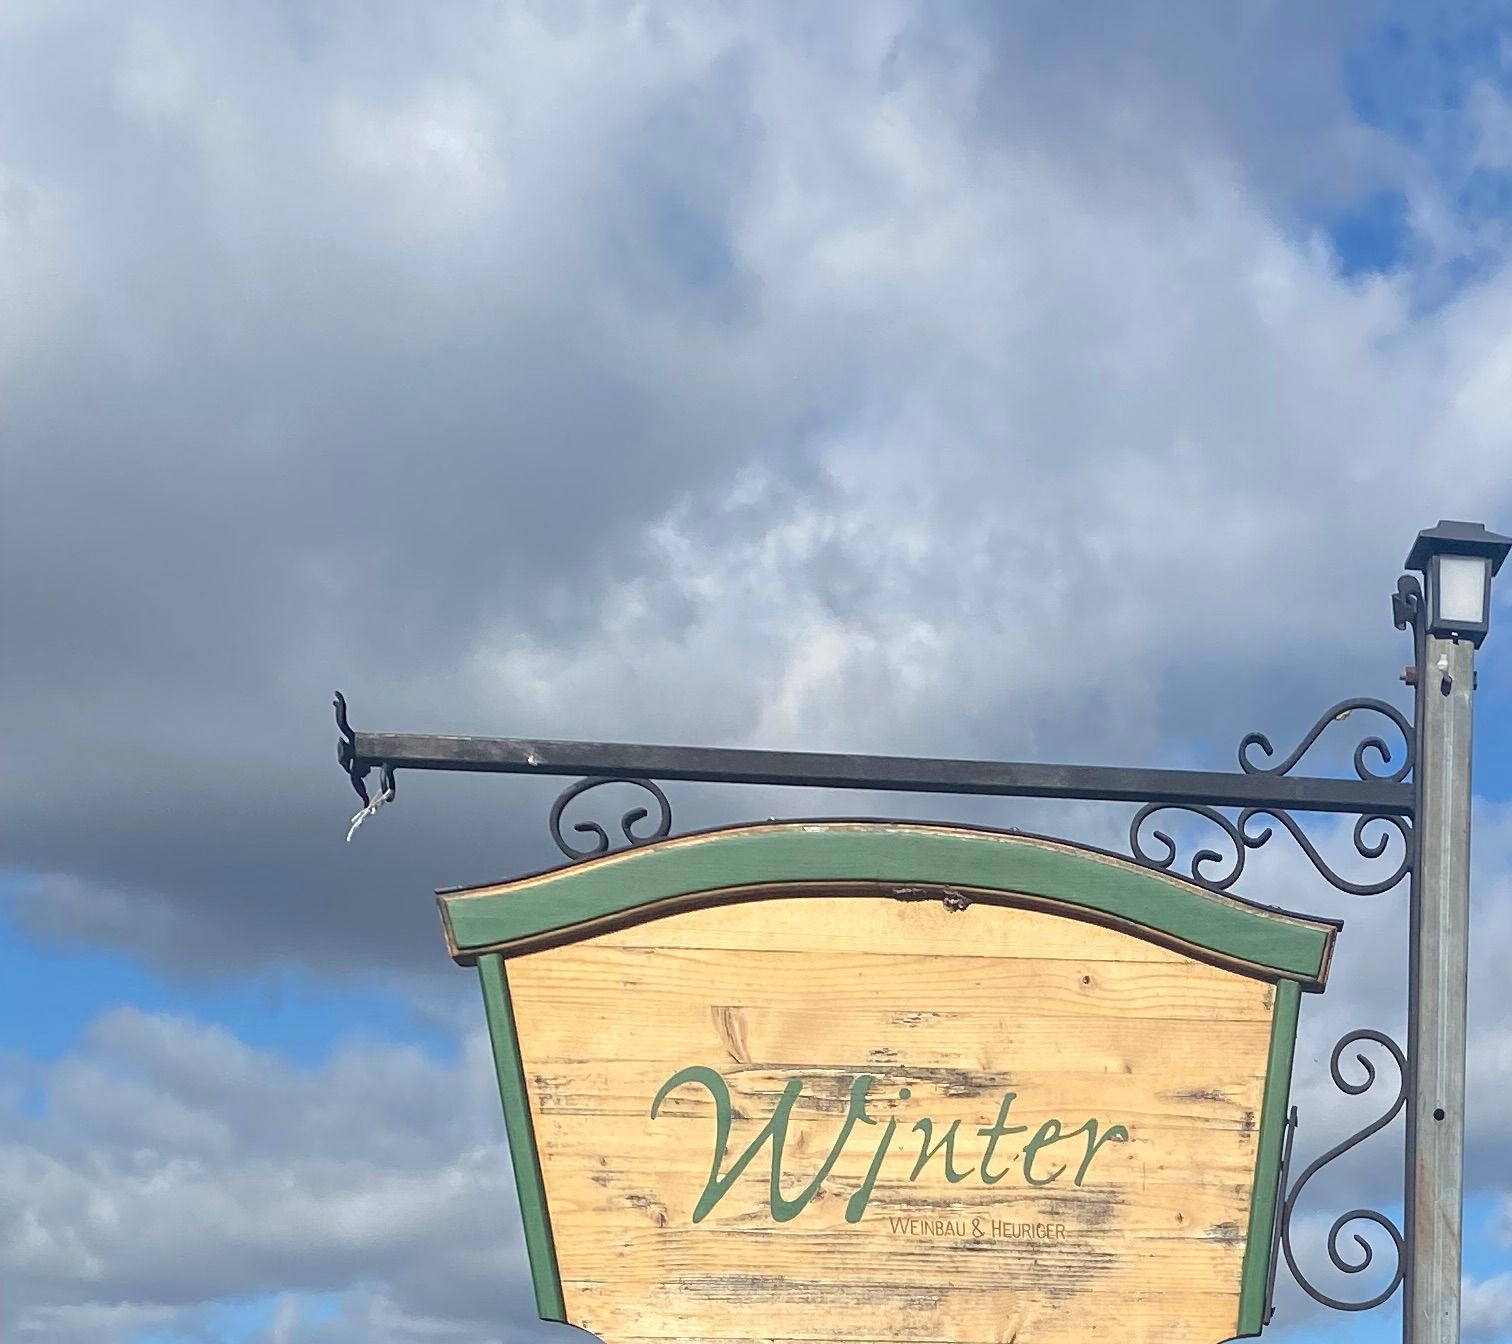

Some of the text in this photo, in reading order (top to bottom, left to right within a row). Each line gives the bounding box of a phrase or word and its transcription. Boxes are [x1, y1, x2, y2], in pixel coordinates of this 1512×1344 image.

[651, 1065, 1130, 1224] Winter
[888, 1216, 1066, 1240] WEINBAU & HEURIGER
